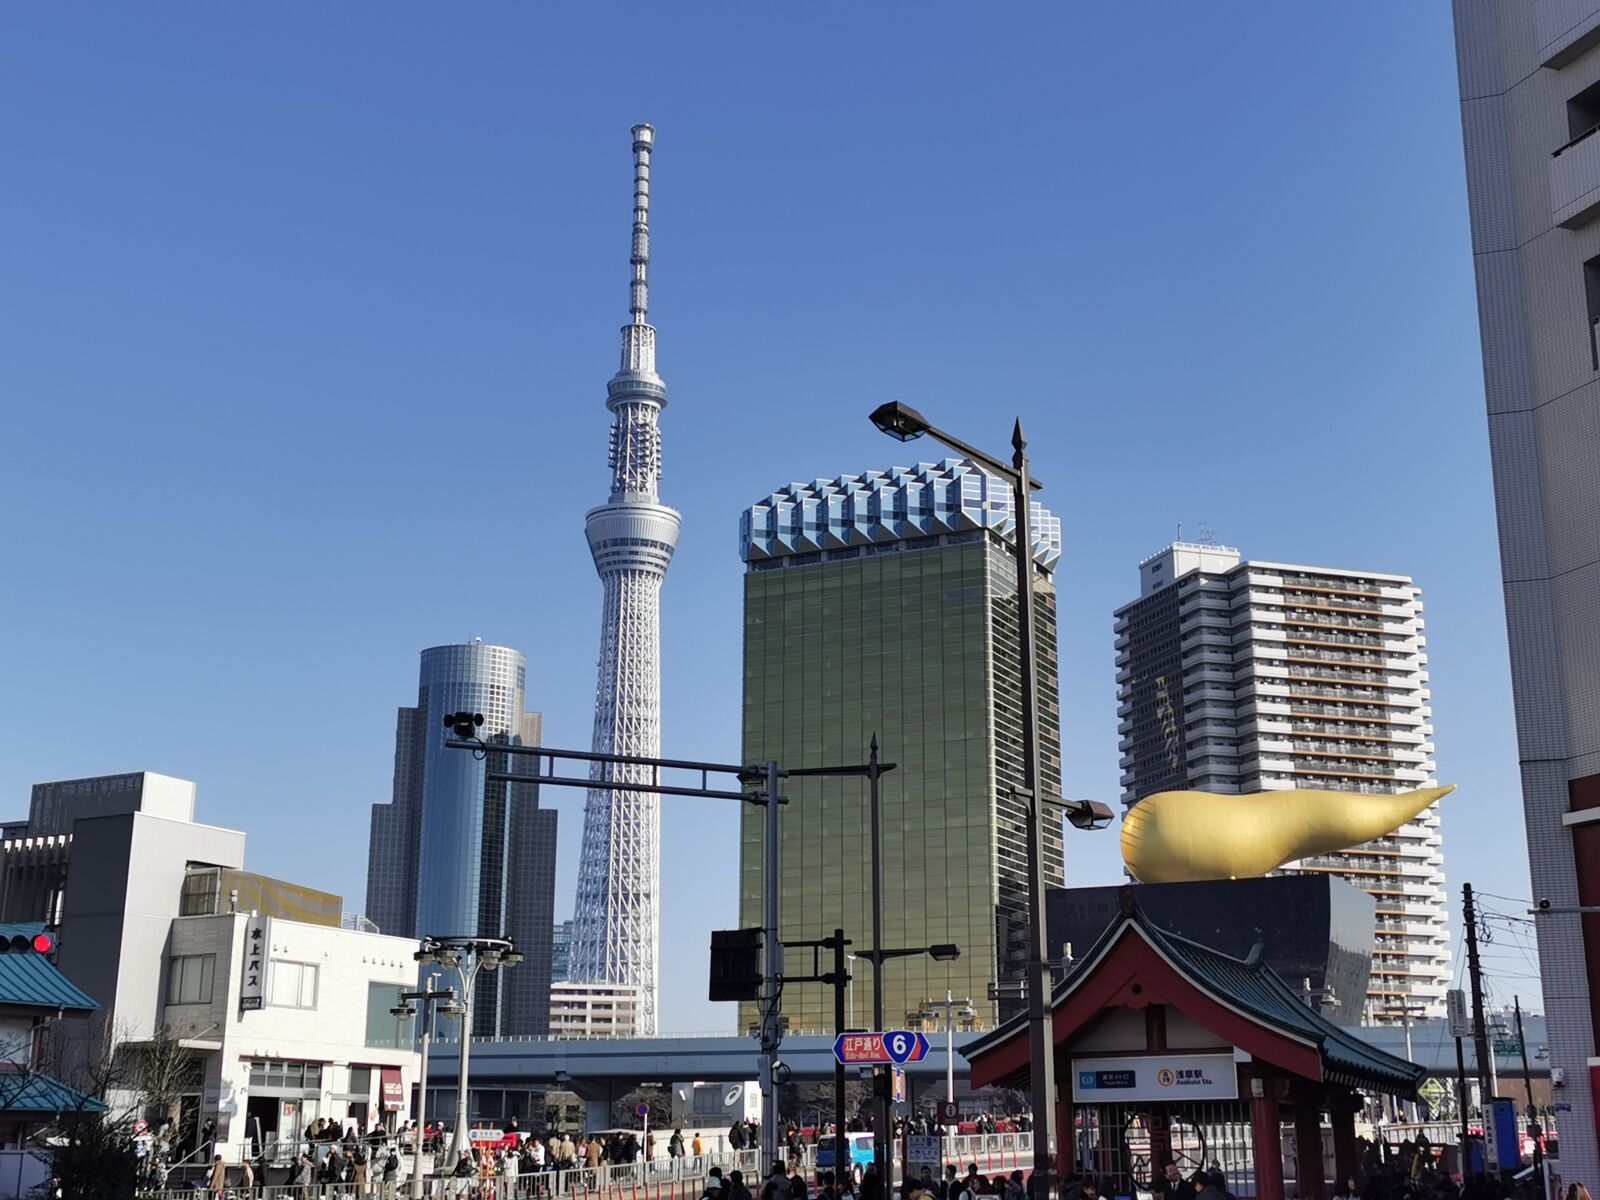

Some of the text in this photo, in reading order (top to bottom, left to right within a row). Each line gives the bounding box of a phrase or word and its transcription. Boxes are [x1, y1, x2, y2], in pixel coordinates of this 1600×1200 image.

[247, 928, 262, 986] 水上バス
[846, 1037, 881, 1052] 江戸通り
[893, 1034, 907, 1055] 6
[1176, 1069, 1203, 1079] 浅草駅
